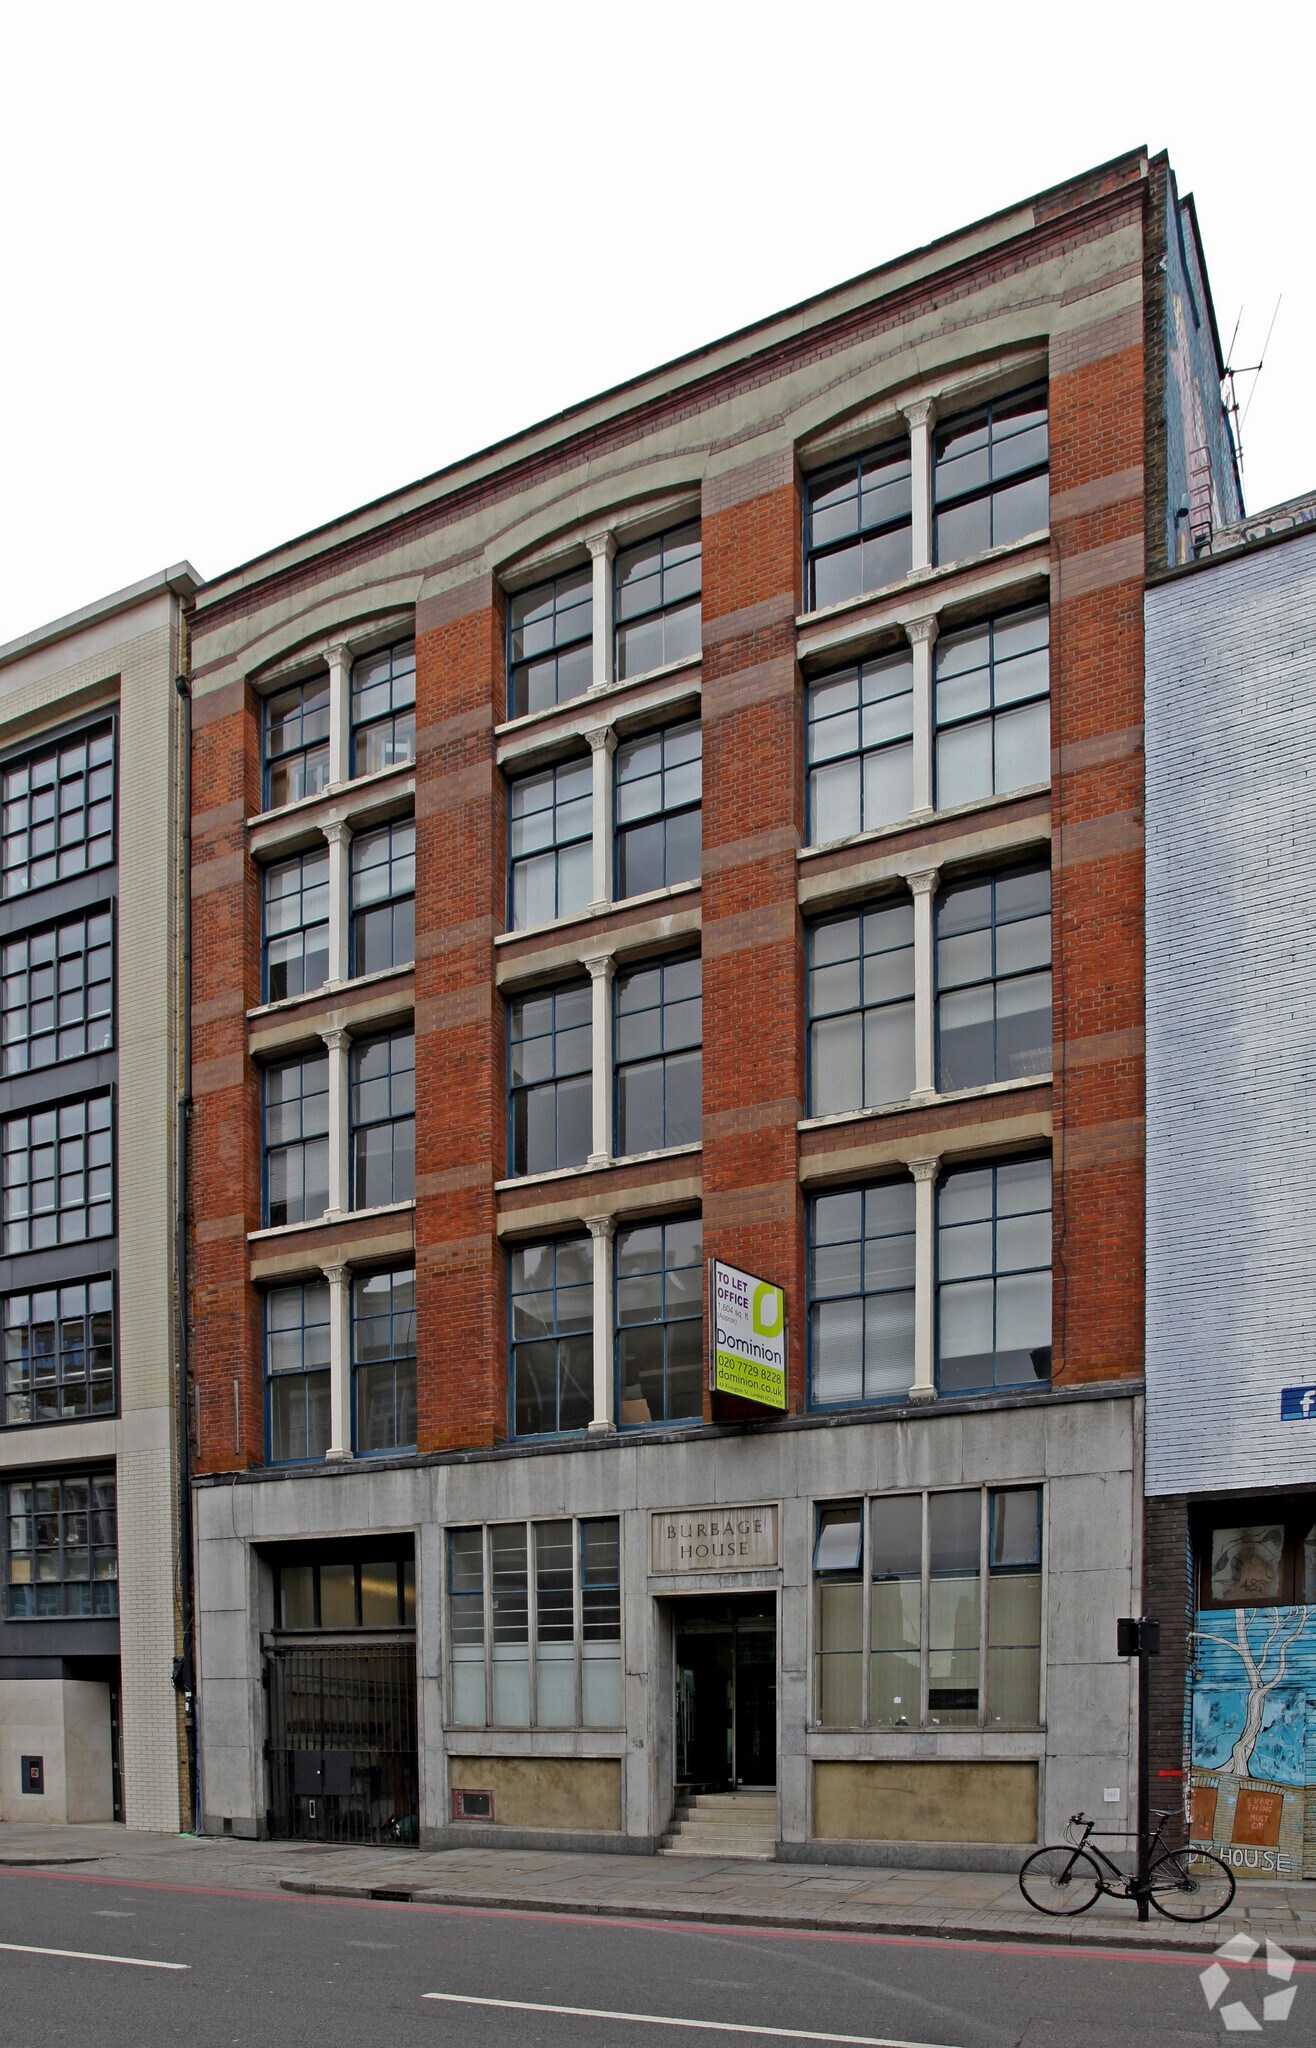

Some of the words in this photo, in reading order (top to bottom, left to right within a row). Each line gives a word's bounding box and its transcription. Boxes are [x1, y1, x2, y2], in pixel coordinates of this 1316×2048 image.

[718, 1271, 729, 1285] TO
[732, 1277, 748, 1292] LET
[717, 1287, 749, 1309] OFFICE
[716, 1328, 781, 1365] Dominion
[718, 1355, 735, 1369] 020
[738, 1361, 759, 1377] 7729
[761, 1369, 781, 1384] 8228
[718, 1368, 783, 1397] dominion.co.uk
[749, 1390, 764, 1400] London
[667, 1519, 763, 1539] BURBAGE
[681, 1541, 749, 1559] HOUSE
[1247, 1796, 1274, 1806] EVERY
[1247, 1804, 1272, 1813] THING
[1250, 1814, 1268, 1822] MUST
[1220, 1847, 1291, 1873] HOUSE
